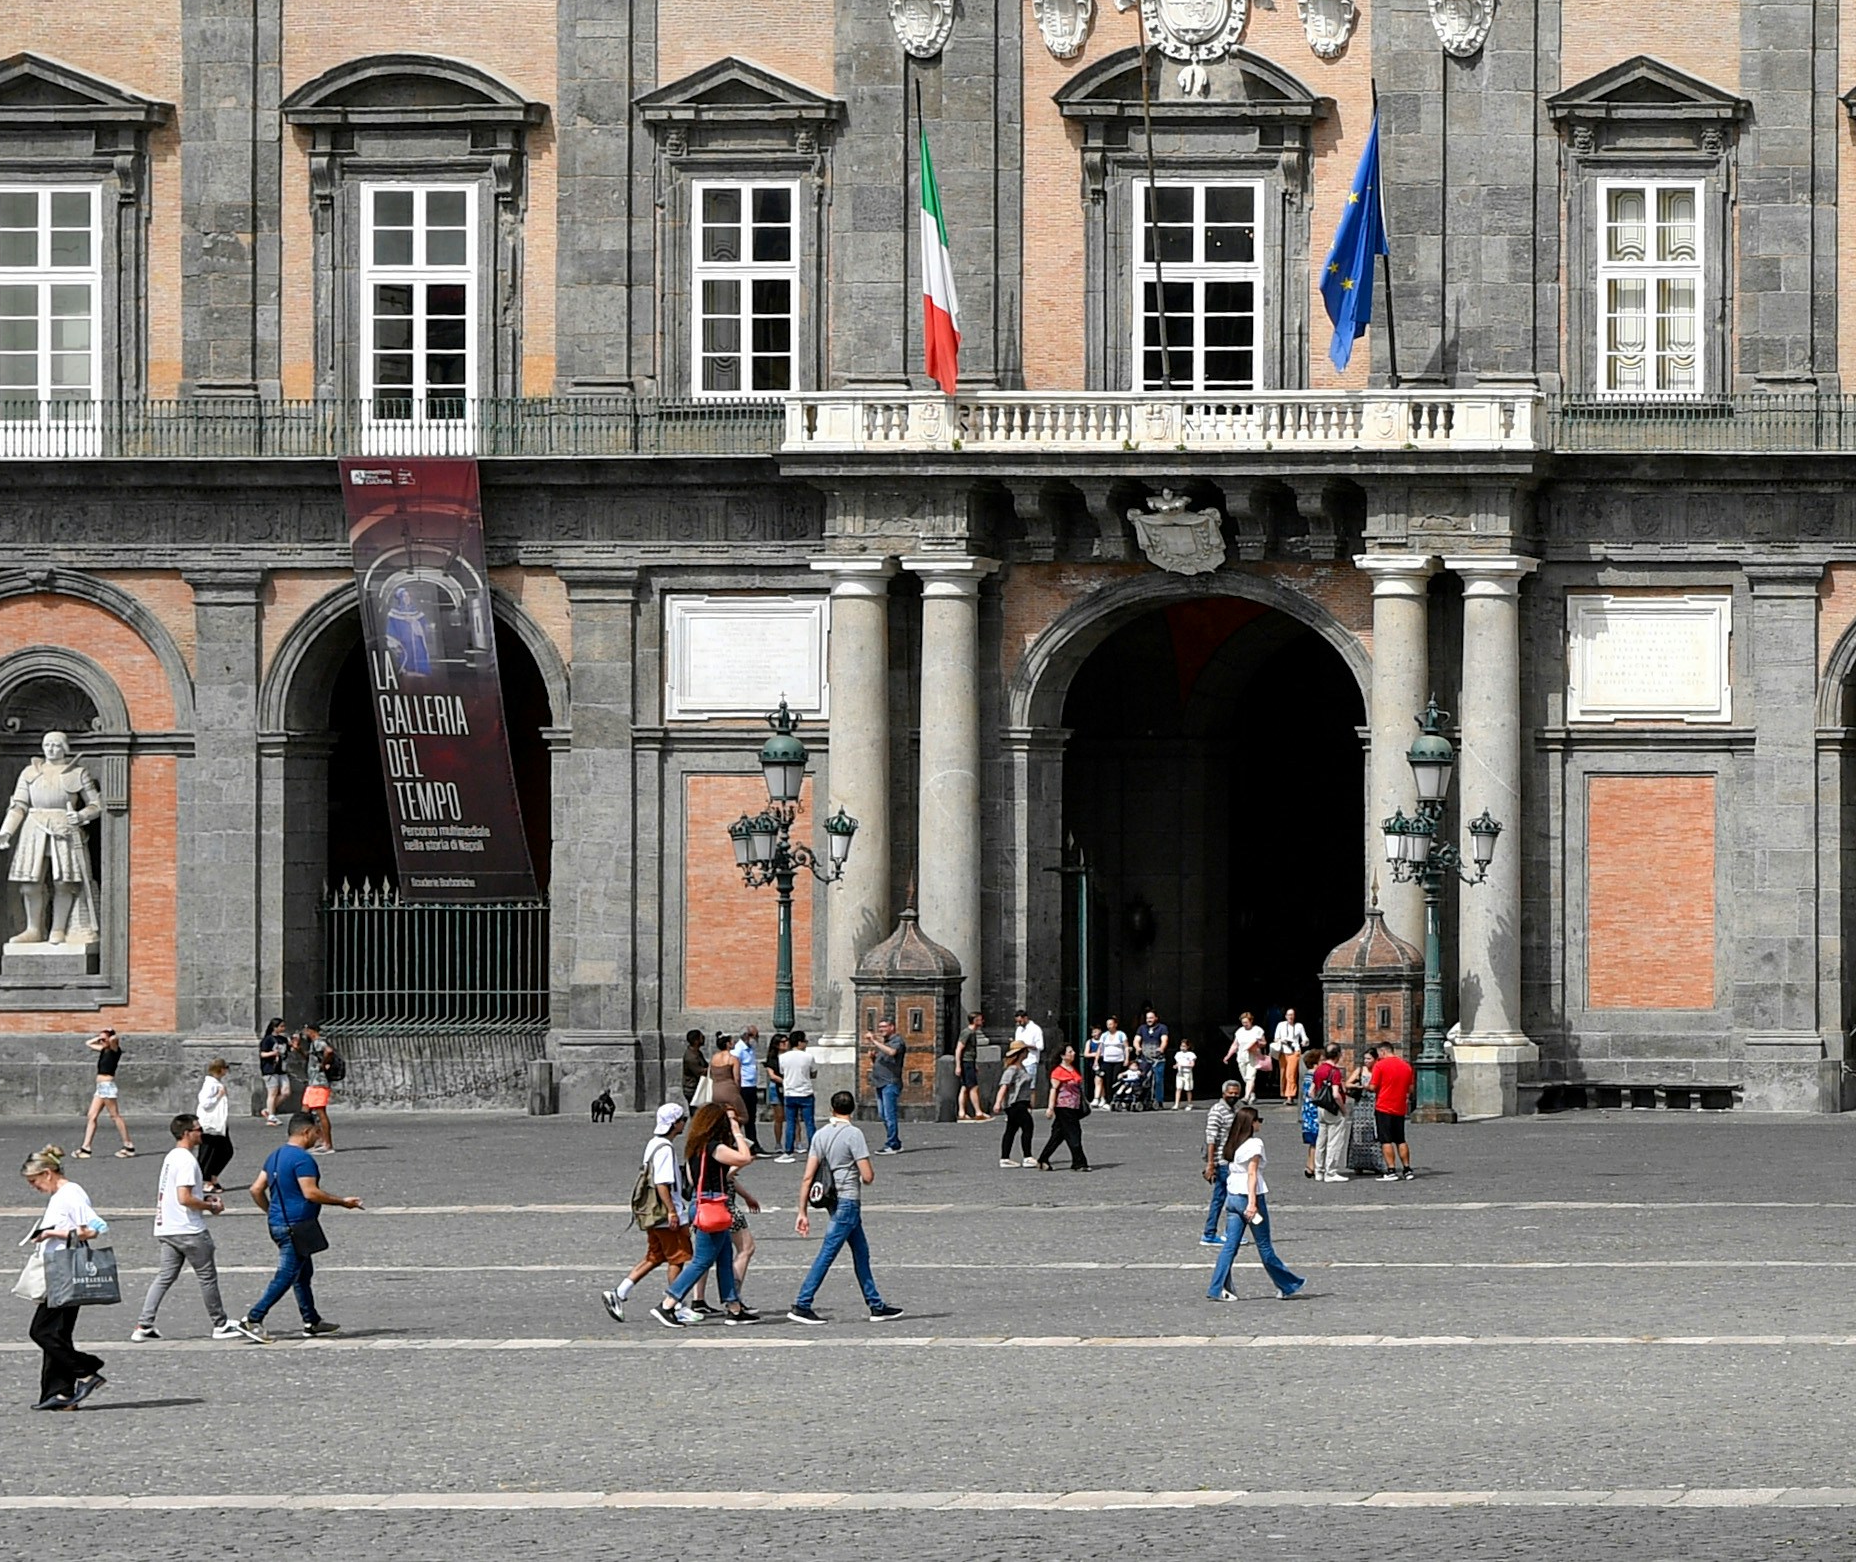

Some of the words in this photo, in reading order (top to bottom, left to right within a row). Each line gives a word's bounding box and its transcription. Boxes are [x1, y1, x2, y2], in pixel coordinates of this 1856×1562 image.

[372, 650, 398, 690] LA
[379, 694, 469, 735] GALLERIA
[385, 738, 424, 778] DEL
[393, 782, 462, 821] TEMPO
[400, 824, 438, 837] Percorso
[438, 825, 491, 837] multimediale
[404, 839, 424, 851] nella
[425, 839, 449, 851] storia
[450, 839, 458, 851] di
[458, 839, 484, 853] Napoli
